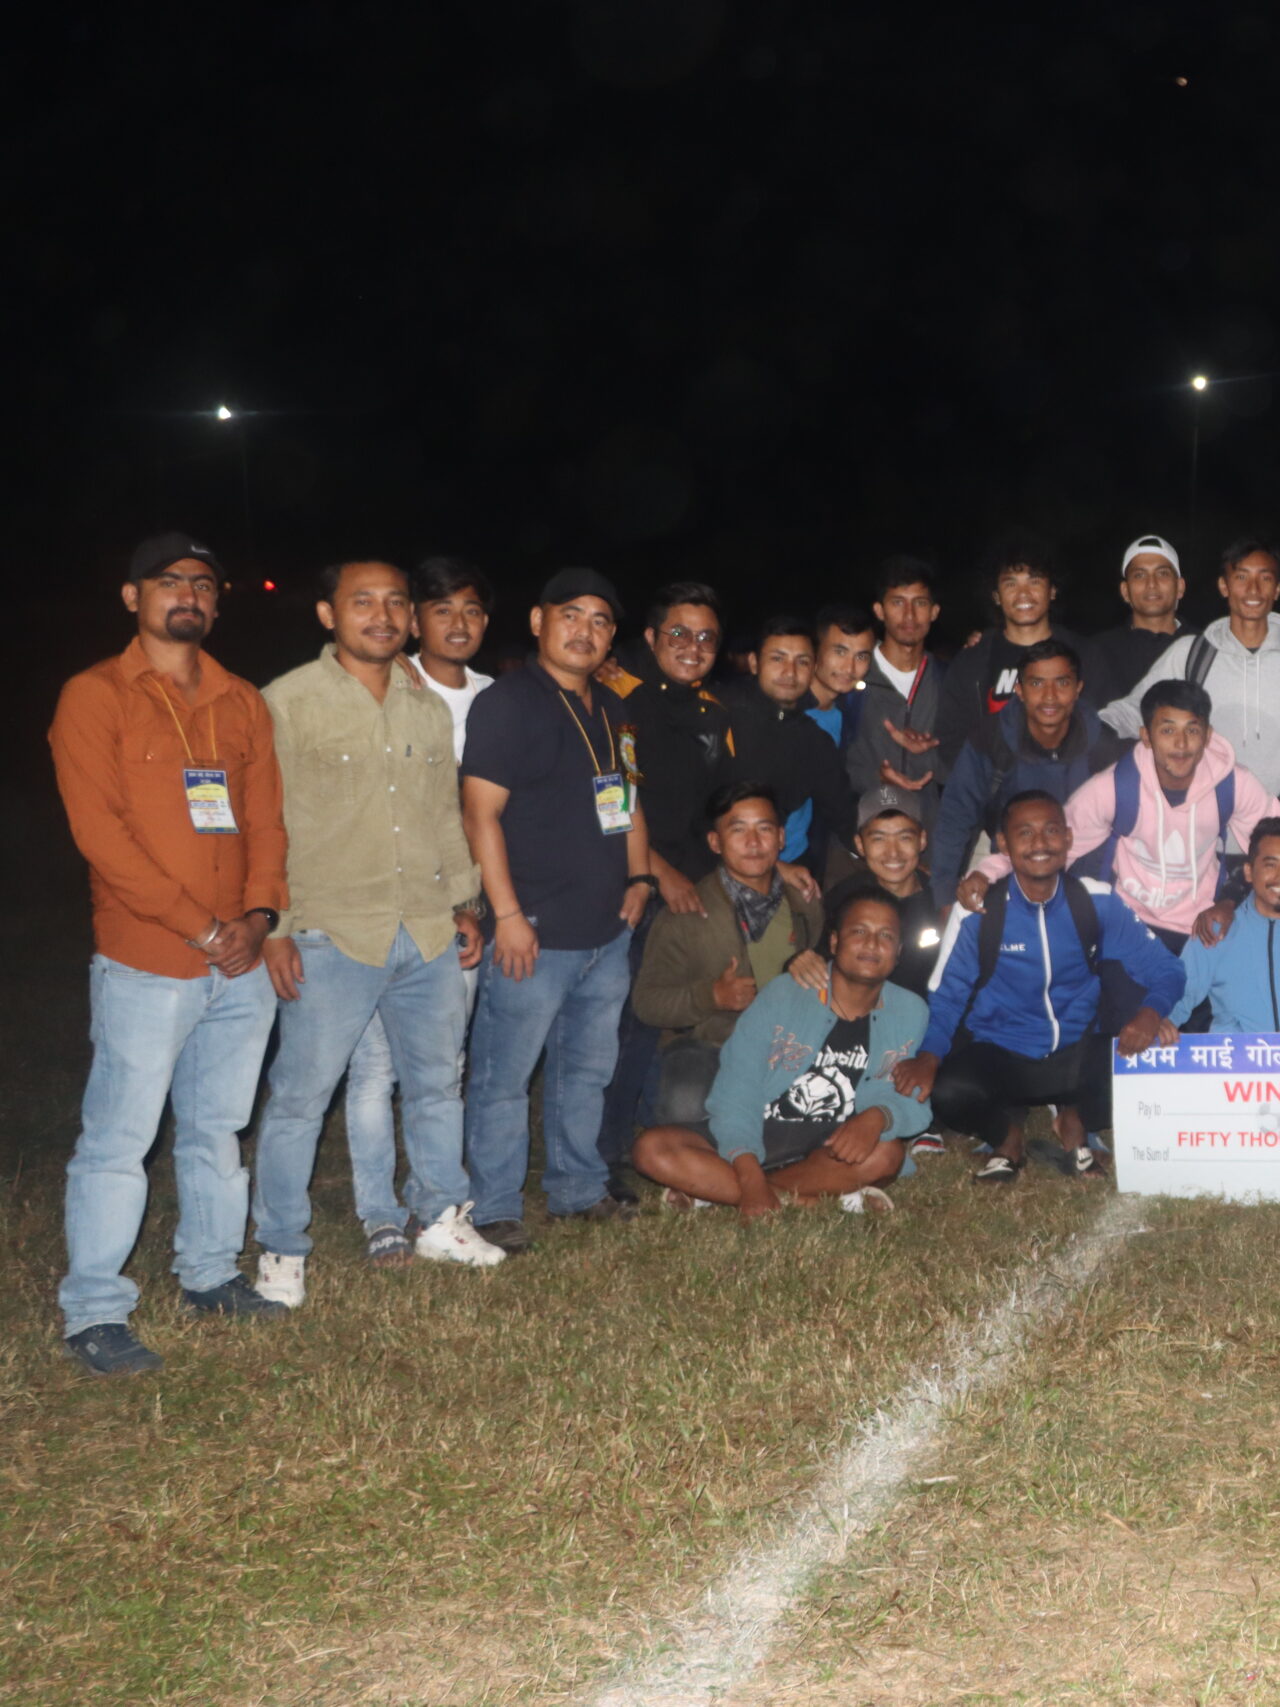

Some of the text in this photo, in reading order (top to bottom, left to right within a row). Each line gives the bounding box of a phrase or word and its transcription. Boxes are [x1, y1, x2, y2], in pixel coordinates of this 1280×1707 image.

[1189, 1038, 1235, 1069] माई
[1137, 1100, 1152, 1119] Pay
[1177, 1131, 1232, 1148] FIFTY
[1132, 1145, 1145, 1161] The
